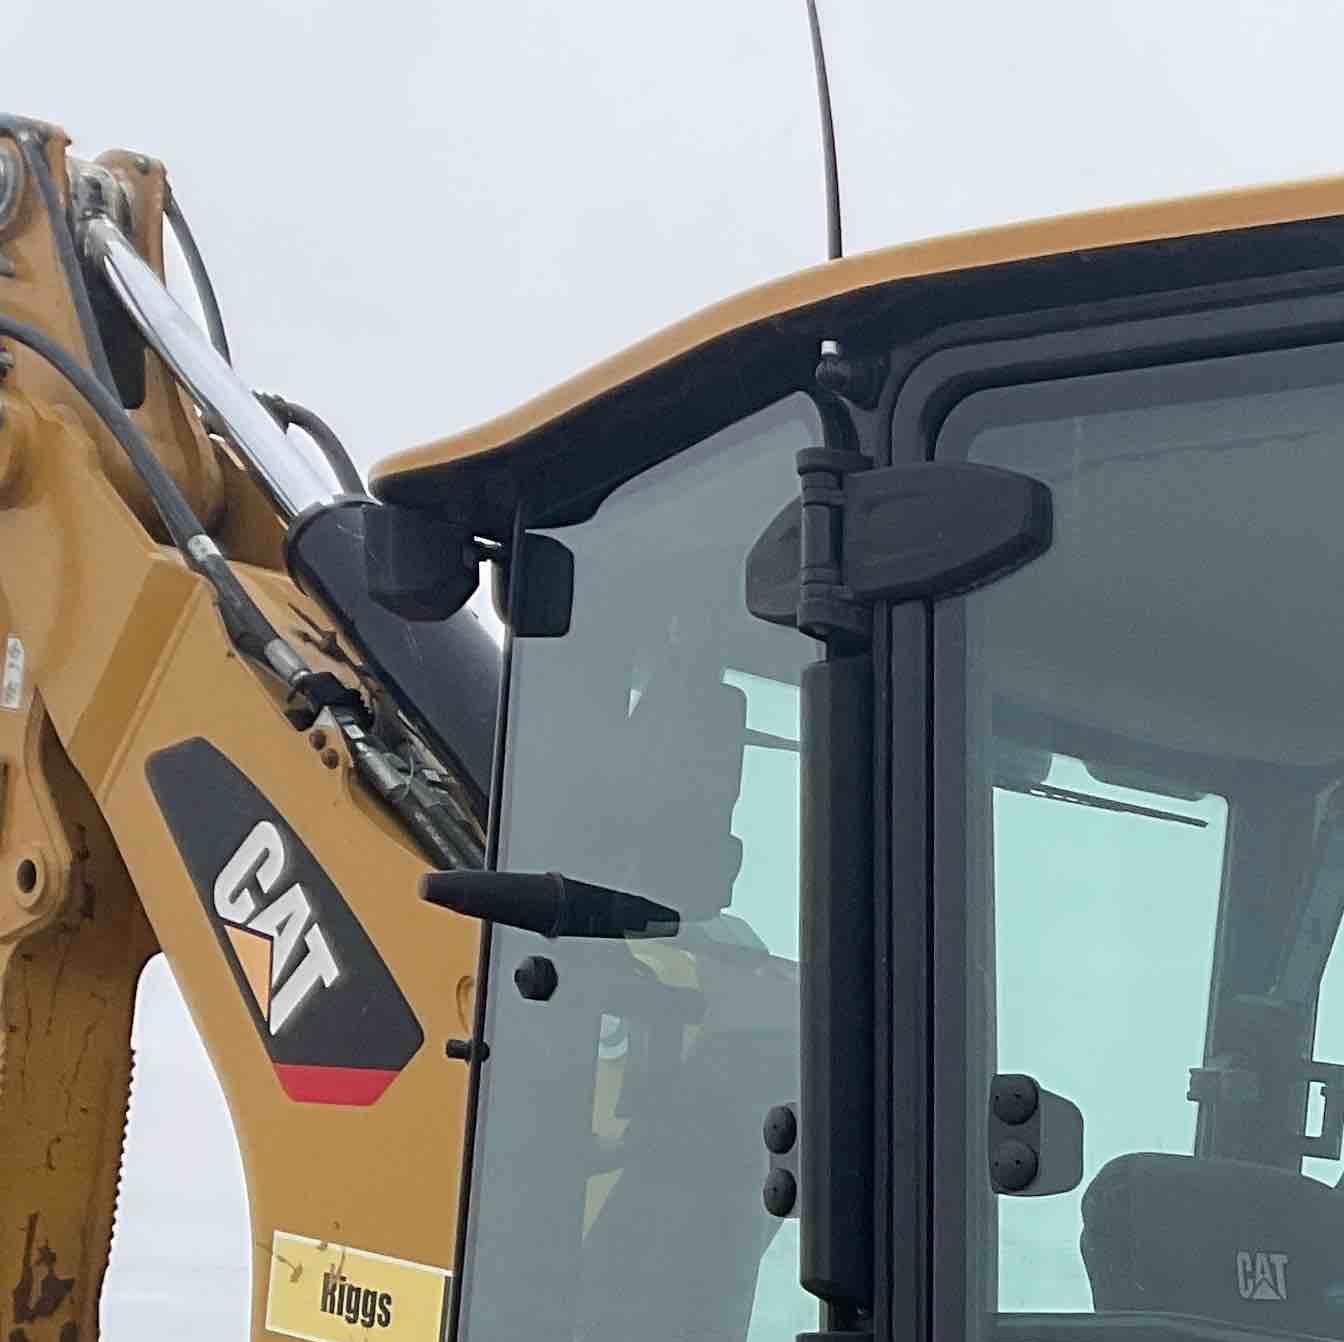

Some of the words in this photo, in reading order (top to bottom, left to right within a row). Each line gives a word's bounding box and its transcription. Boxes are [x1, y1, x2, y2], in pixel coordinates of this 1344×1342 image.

[214, 820, 341, 1036] CAT
[320, 1271, 393, 1329] Riggs
[1237, 1251, 1288, 1300] CAT
